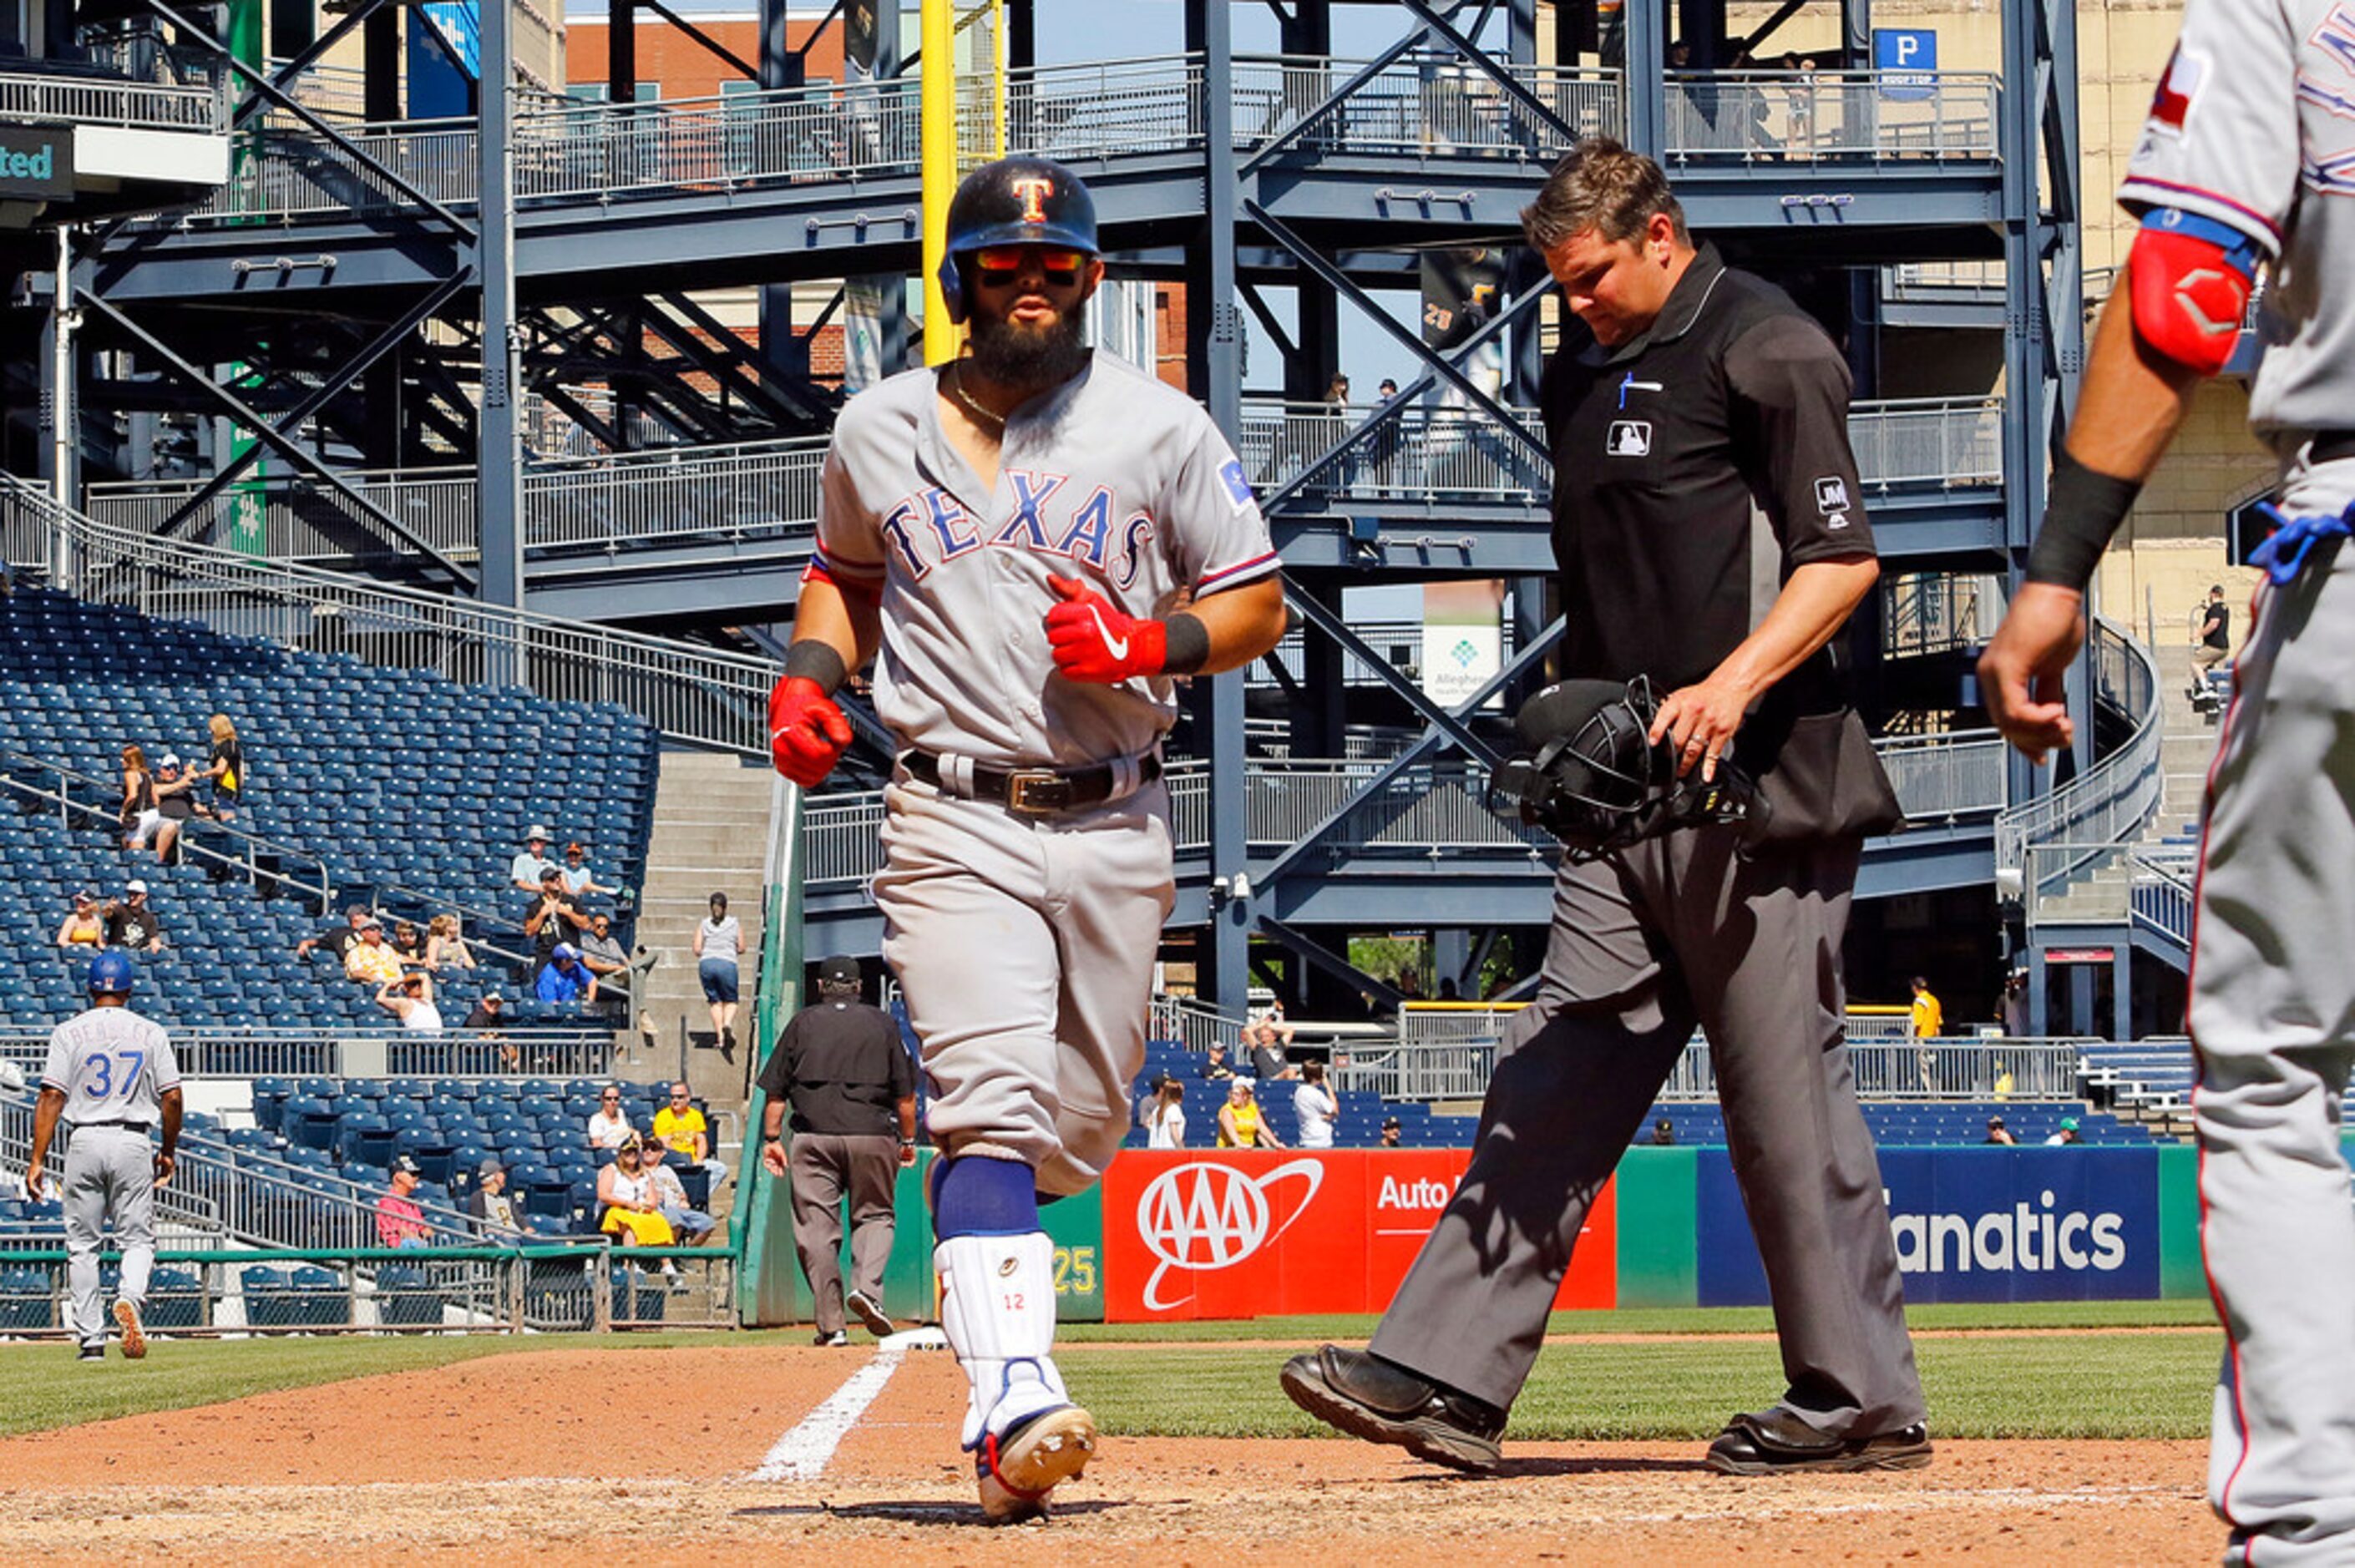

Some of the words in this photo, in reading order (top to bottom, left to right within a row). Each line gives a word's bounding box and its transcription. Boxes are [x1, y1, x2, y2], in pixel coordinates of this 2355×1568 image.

[1896, 35, 1919, 65] P
[1012, 177, 1054, 224] T
[880, 468, 1156, 592] TEXAS
[85, 1050, 144, 1099] 37
[1151, 1166, 1257, 1265] AAA
[1375, 1175, 1450, 1209] Auto
[1881, 1187, 2127, 1273] anatics
[1004, 1293, 1025, 1310] 12
